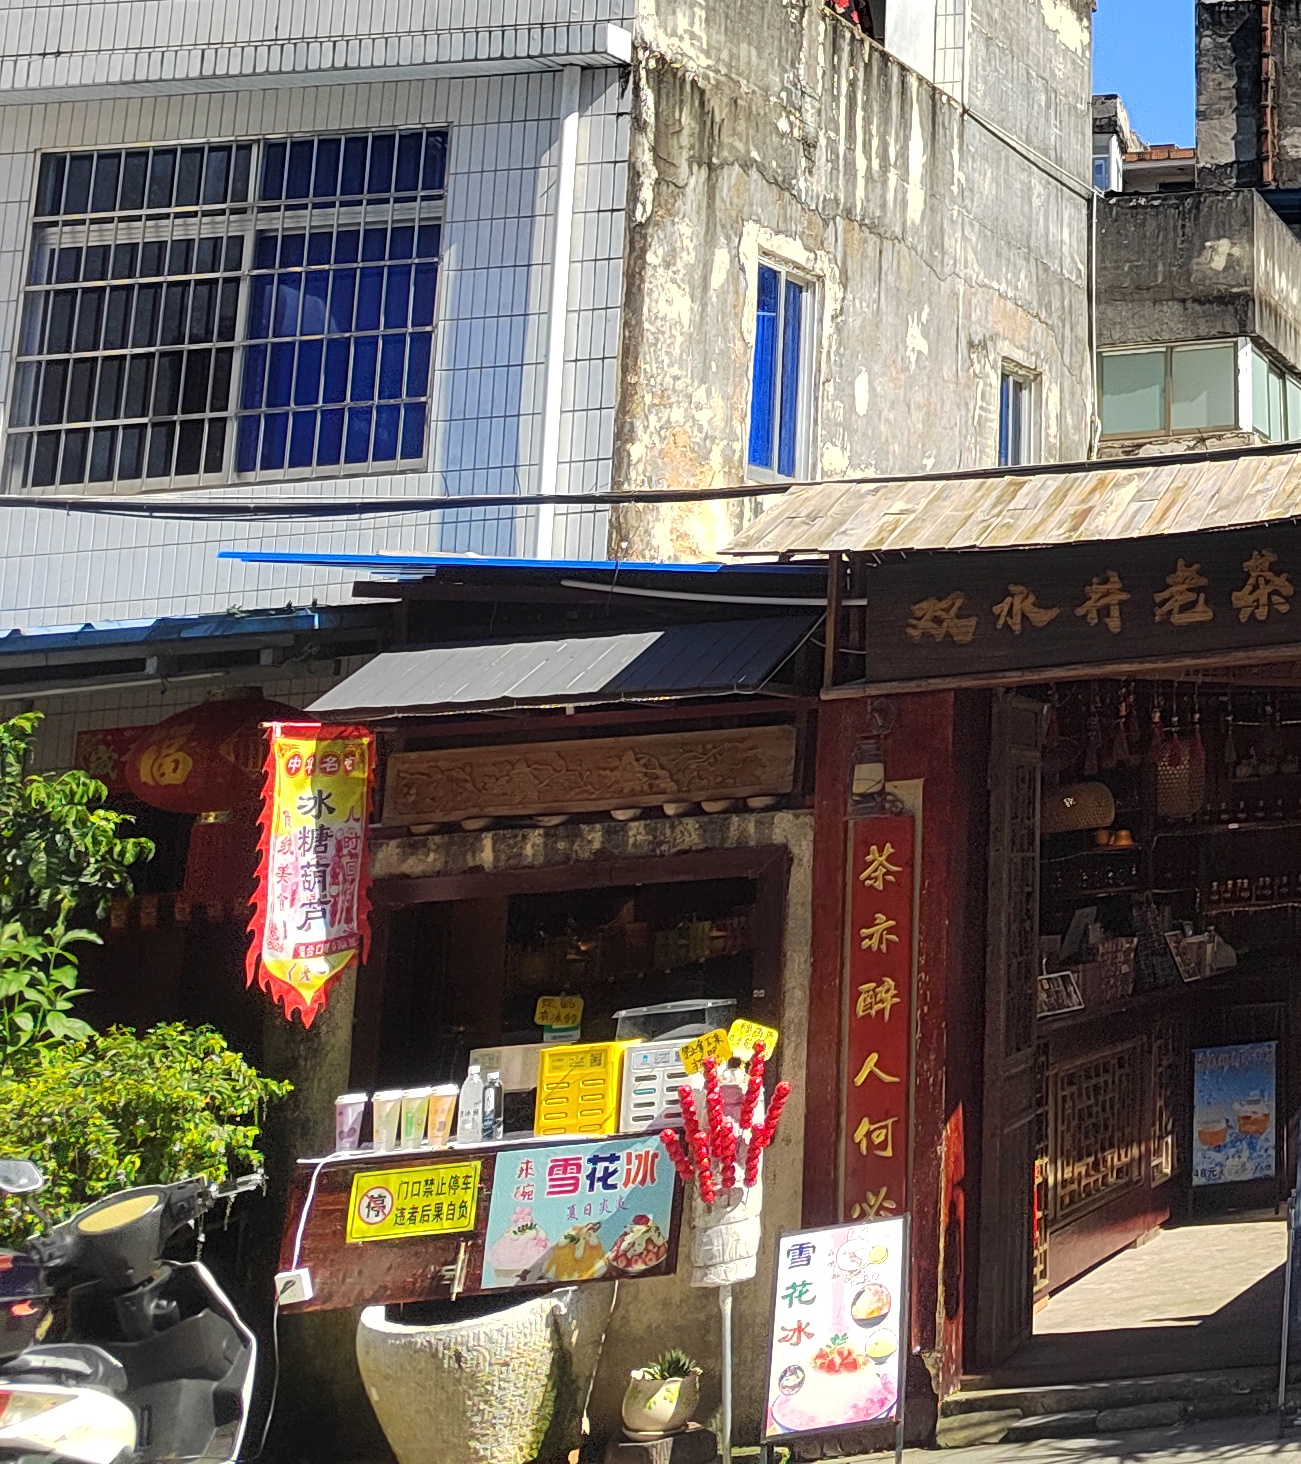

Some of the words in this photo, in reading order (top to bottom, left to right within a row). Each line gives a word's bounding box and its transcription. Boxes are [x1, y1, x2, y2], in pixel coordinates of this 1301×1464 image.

[296, 789, 337, 932] 冰糖葫芦
[397, 1174, 473, 1201] 门口禁止停车
[546, 1150, 660, 1197] 雪花冰
[394, 1200, 469, 1227] 违者后果自负
[778, 1242, 816, 1346] 雪花冰
